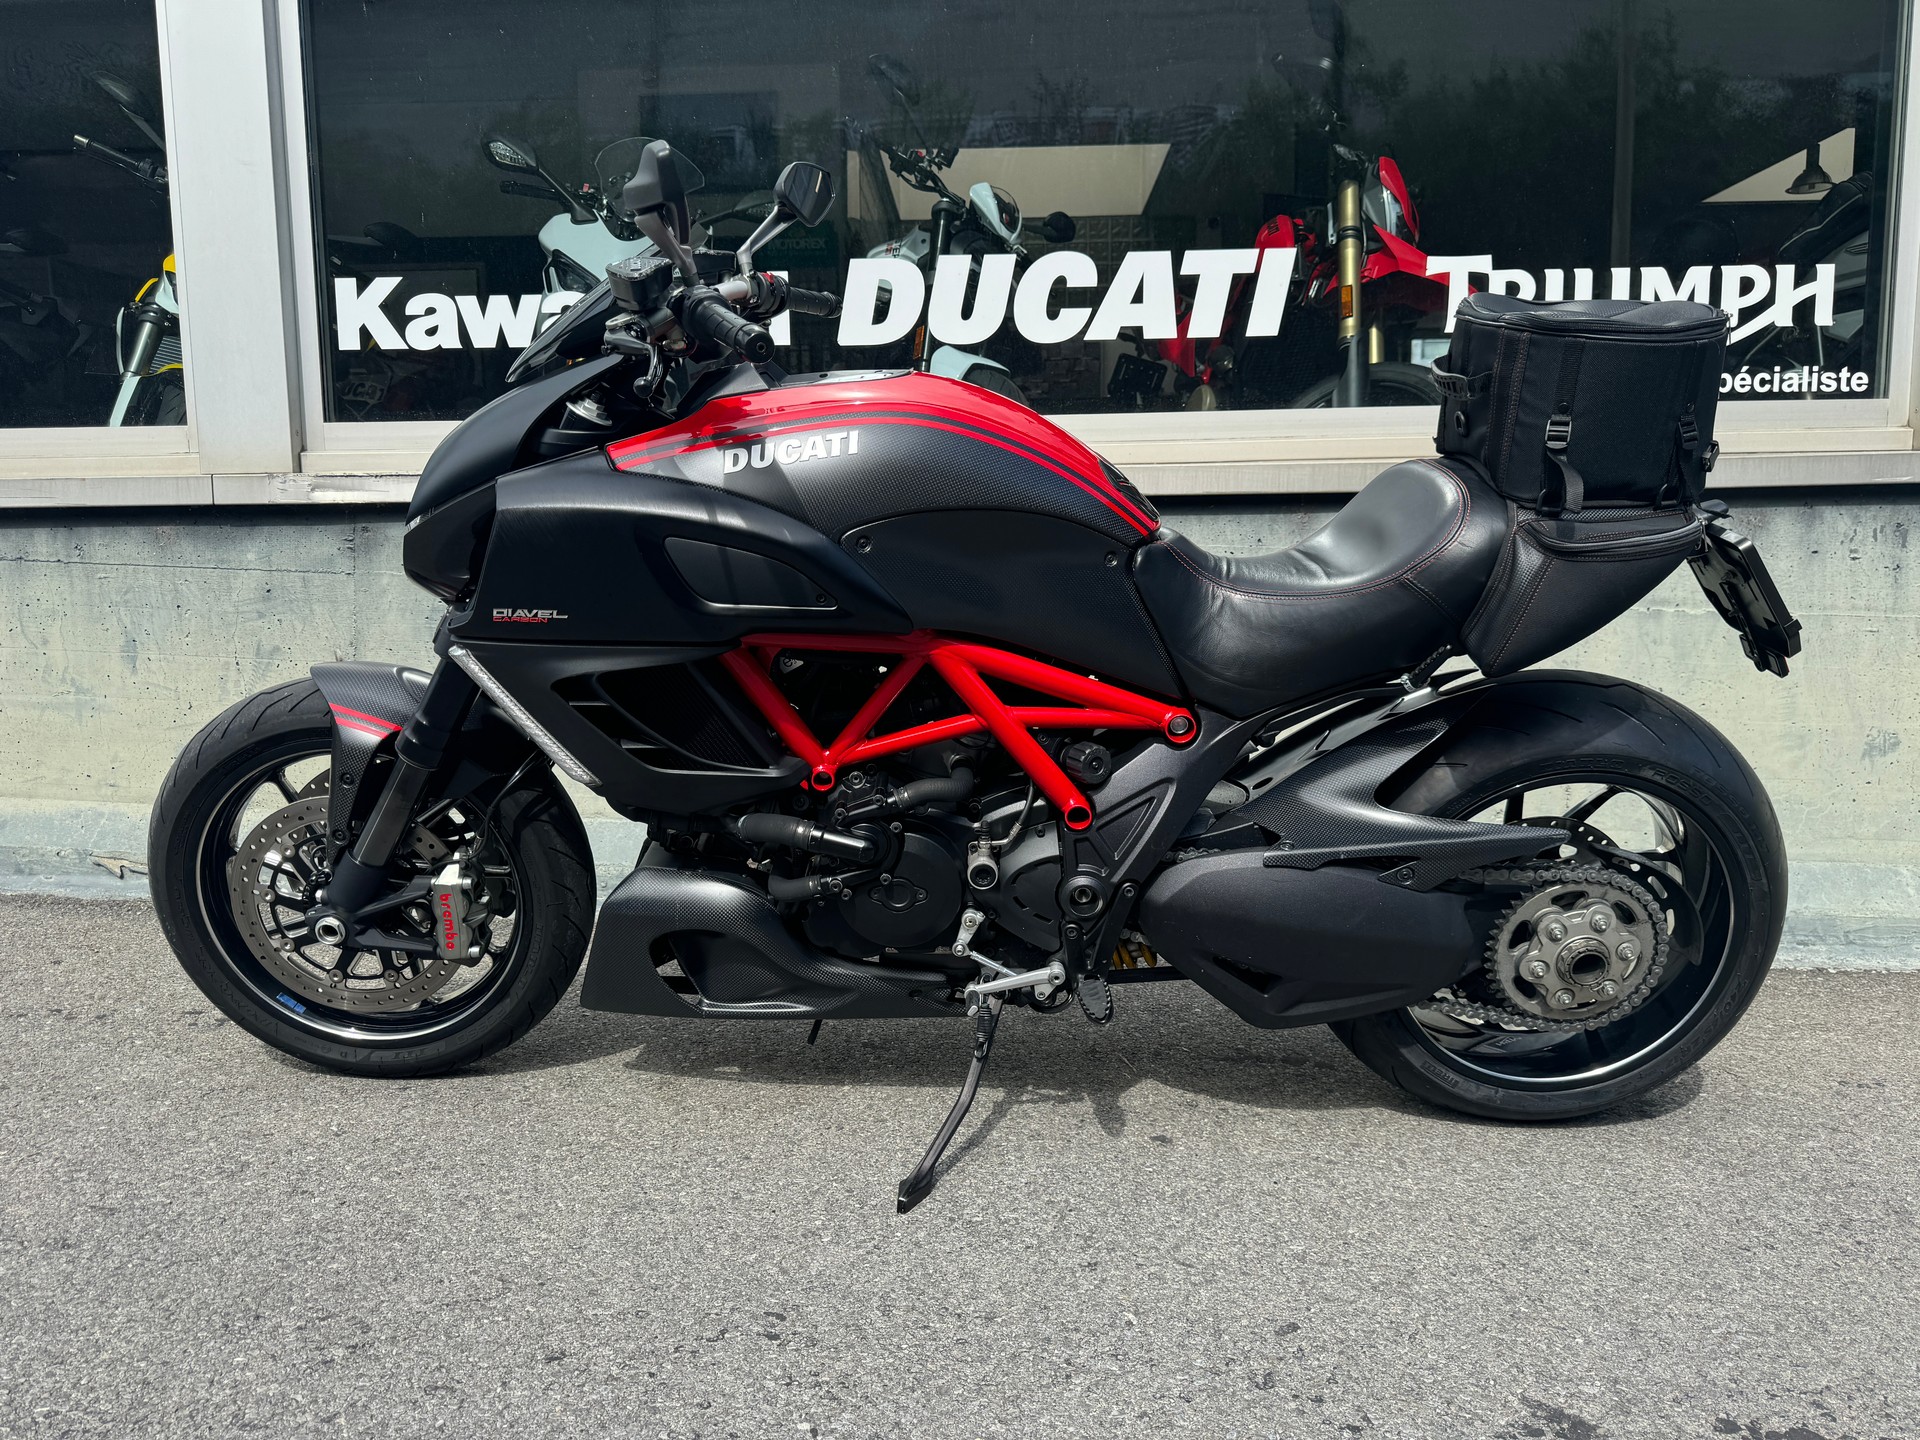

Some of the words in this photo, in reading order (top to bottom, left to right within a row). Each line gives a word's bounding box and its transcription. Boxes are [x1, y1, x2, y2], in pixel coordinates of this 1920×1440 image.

[837, 247, 1297, 347] DUCATI
[1719, 365, 1870, 394] pécialiste
[723, 430, 860, 474] DUCATI
[493, 608, 569, 619] DIAVEL
[439, 893, 459, 951] brembo
